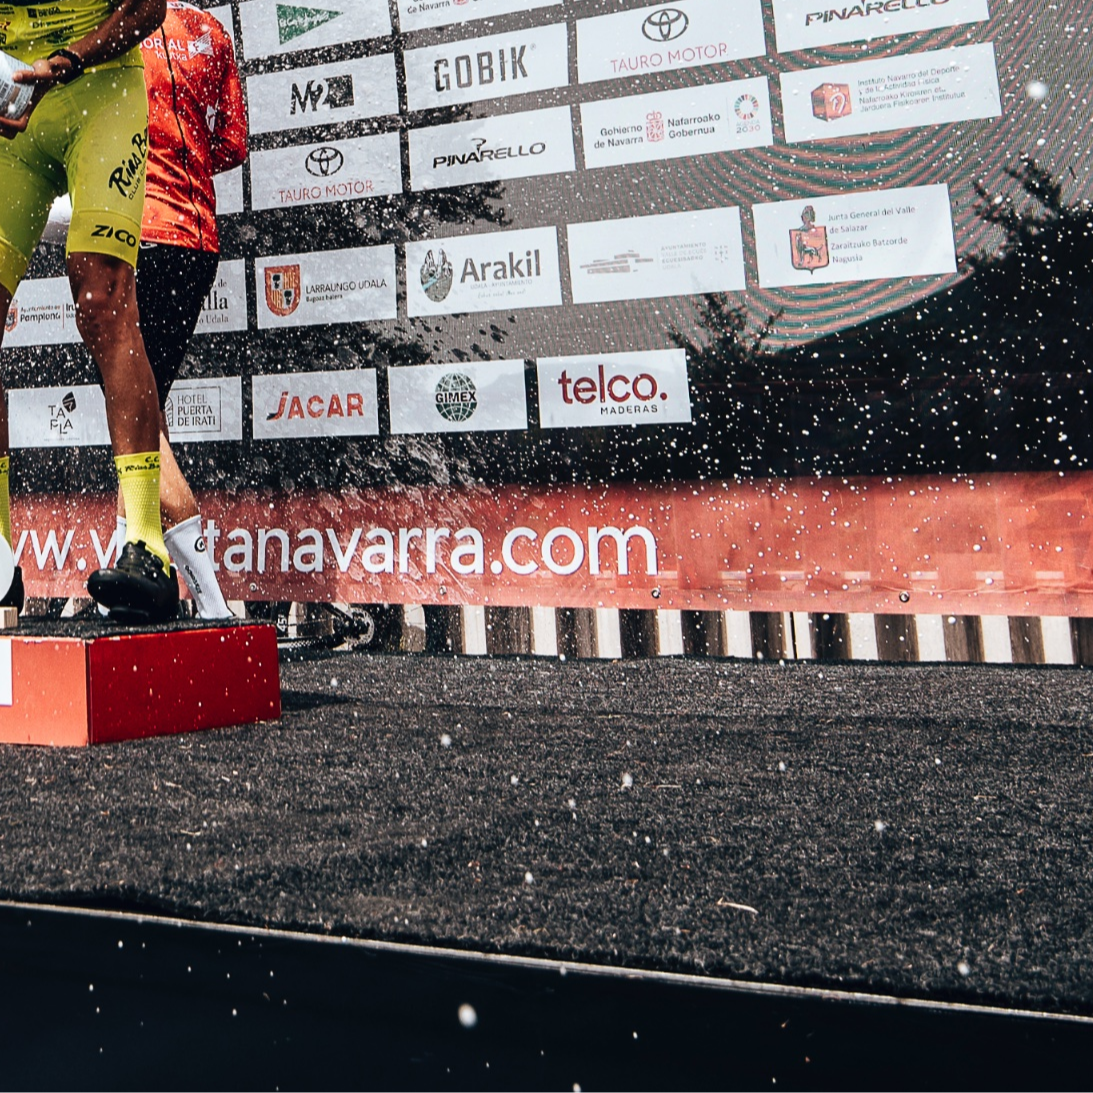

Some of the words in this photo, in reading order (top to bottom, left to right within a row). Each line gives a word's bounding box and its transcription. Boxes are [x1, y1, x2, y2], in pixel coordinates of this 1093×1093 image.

[610, 54, 663, 74] TAURO
[668, 42, 728, 63] MOTOR
[434, 45, 527, 92] GOBIK
[668, 113, 720, 128] Nafarroako
[669, 126, 715, 139] Gobernua
[594, 139, 605, 148] de
[607, 134, 644, 148] Navarra
[432, 138, 546, 169] PINARELLO
[279, 188, 322, 204] TAURO
[326, 180, 374, 198] MOTOR
[850, 210, 880, 219] General
[895, 206, 915, 214] Valle
[841, 225, 867, 233] Salazar
[91, 224, 136, 248] ZICO
[831, 240, 871, 250] Zaraitzuko
[832, 254, 863, 263] Nagusia
[460, 249, 540, 283] Arakil
[218, 279, 227, 287] de
[306, 281, 356, 294] LARRAUNGO
[358, 279, 387, 289] UDALA
[20, 313, 61, 322] Pamplona
[206, 315, 228, 324] Udala
[559, 364, 668, 405] telco.
[178, 394, 207, 404] HOTEL
[435, 390, 477, 404] GIMEX
[178, 406, 212, 415] PUERTA
[600, 405, 658, 415] MADERAS
[178, 417, 189, 426] DE
[192, 416, 215, 426] IRATI
